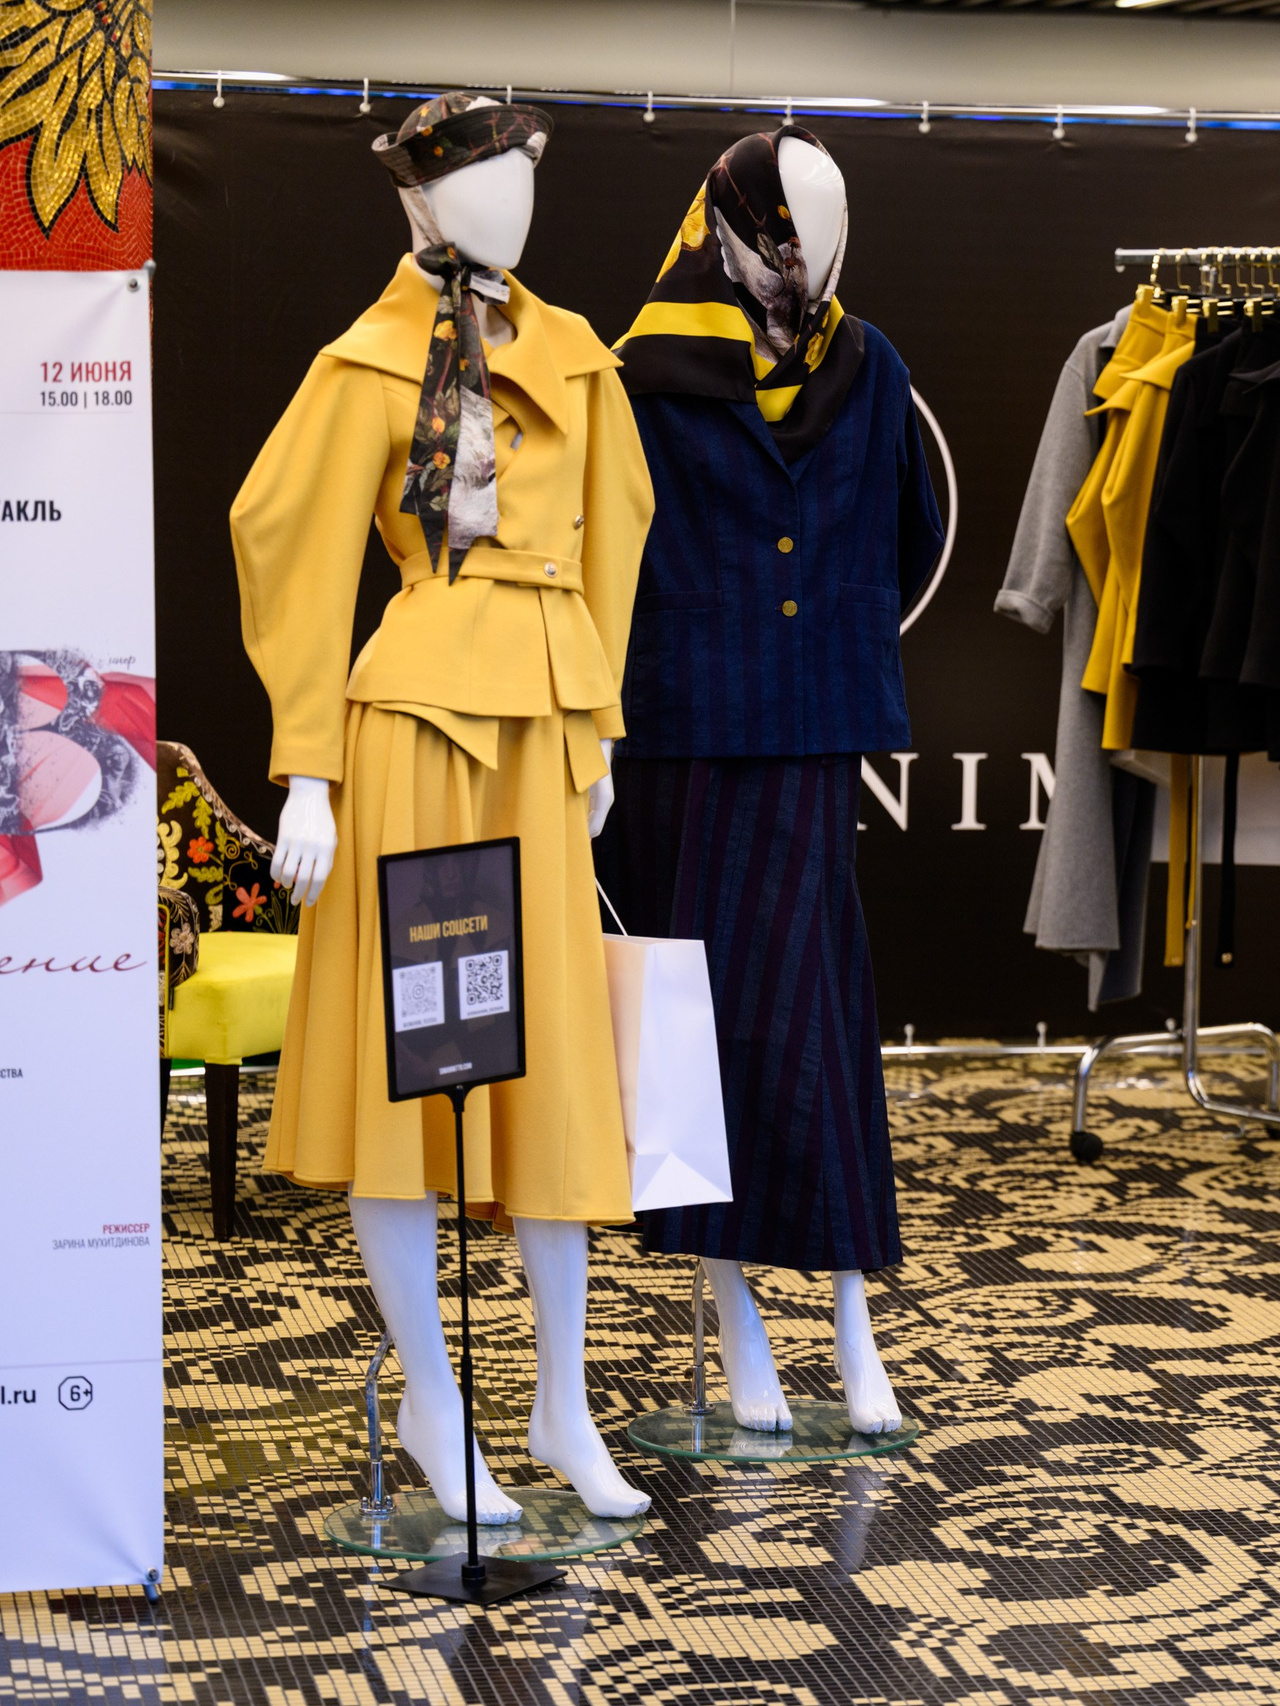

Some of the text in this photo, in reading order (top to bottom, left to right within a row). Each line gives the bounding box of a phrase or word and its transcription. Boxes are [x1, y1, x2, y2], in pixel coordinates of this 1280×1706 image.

[40, 360, 132, 383] 12 ИЮНЯ
[40, 391, 78, 406] 15.00
[94, 390, 133, 406] 18.00
[0, 500, 62, 522] АКЛЬ
[410, 914, 488, 943] НАШИ СОЦСЕТИ
[0, 1068, 23, 1079] СТВА
[102, 1223, 150, 1234] РЕЖИССЕР
[52, 1236, 150, 1250] ЗАРИНА МУХИТДИНОВА
[70, 1384, 92, 1402] 6+
